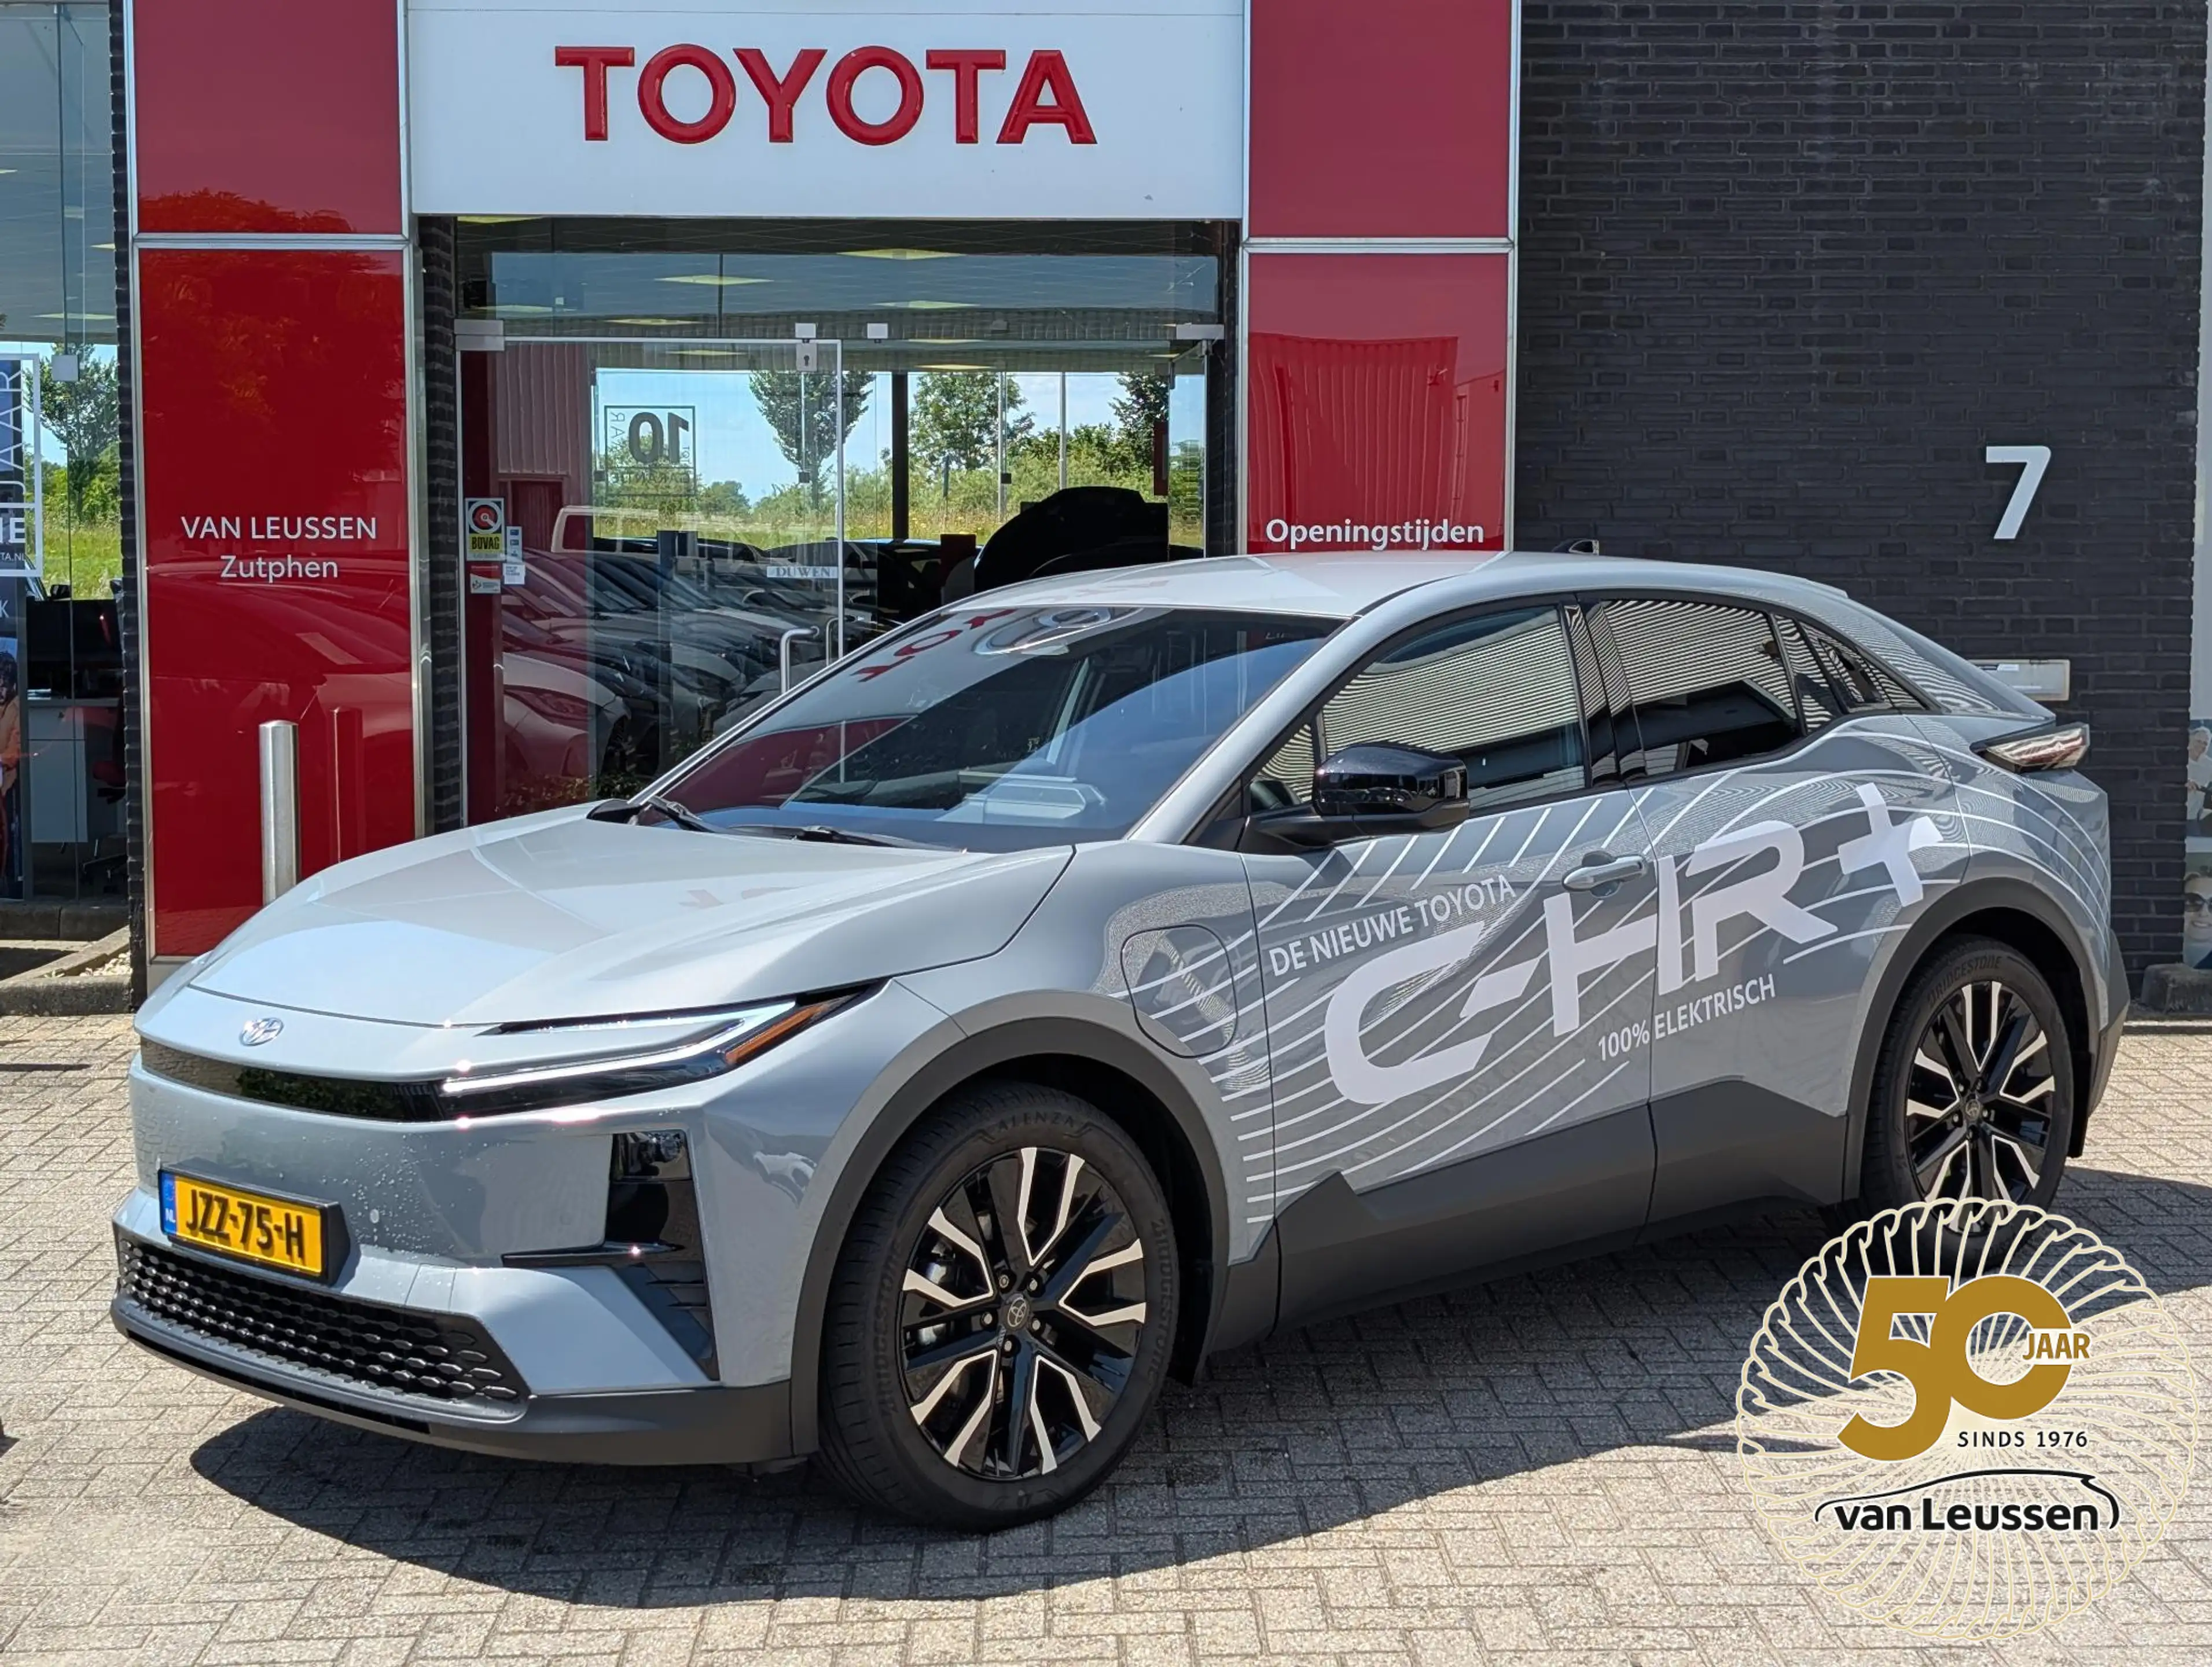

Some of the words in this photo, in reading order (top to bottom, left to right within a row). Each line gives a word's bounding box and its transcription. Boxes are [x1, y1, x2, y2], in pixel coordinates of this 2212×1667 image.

[555, 43, 1097, 145] TOYOTA
[1986, 446, 2051, 539] 7
[181, 516, 240, 539] VAN
[252, 516, 376, 539] LEUSSEN
[472, 537, 500, 550] BOVAG
[1266, 519, 1484, 551] Openingstijden
[221, 554, 338, 583] Zutphen
[776, 567, 830, 577] DUWEN
[1269, 941, 1307, 976] DE
[1310, 905, 1413, 964] NIEUWE
[1414, 875, 1517, 926] TOYOTA
[1598, 1018, 1650, 1061] 100%
[1654, 974, 1776, 1039] ELEKTRISCH
[165, 1207, 176, 1222] NL
[186, 1189, 304, 1260] JZZ-75-H
